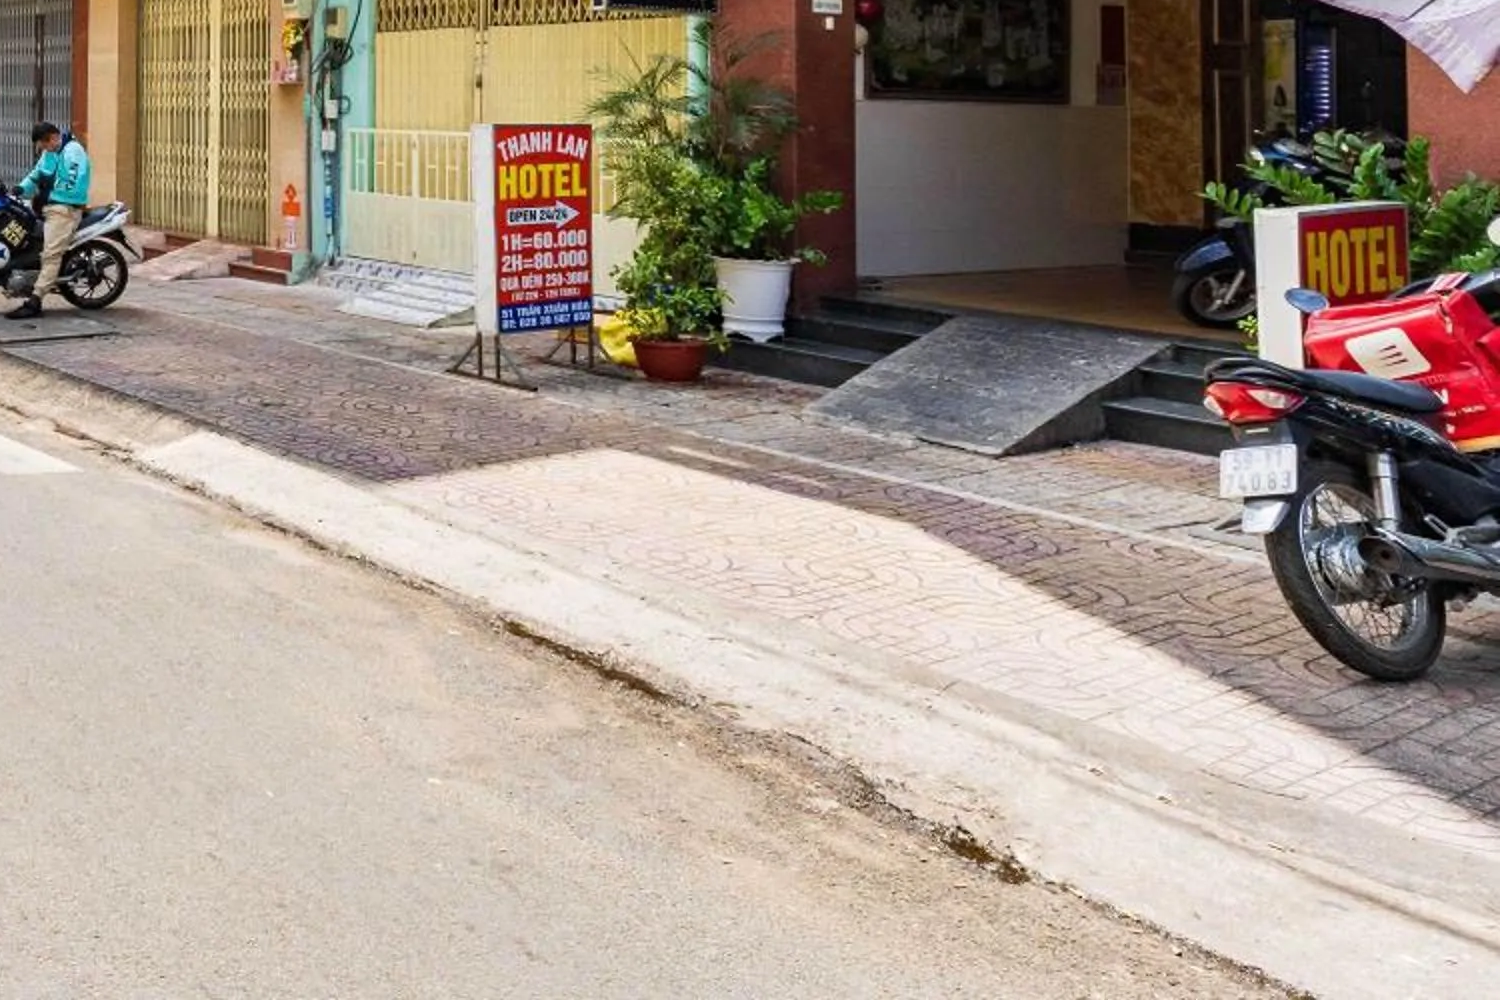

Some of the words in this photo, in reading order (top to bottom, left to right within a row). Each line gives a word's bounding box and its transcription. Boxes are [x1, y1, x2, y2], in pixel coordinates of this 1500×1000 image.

[497, 131, 553, 162] THANH
[557, 131, 589, 161] LAN
[499, 162, 588, 200] HOTEL
[509, 209, 537, 223] OPEN
[539, 207, 569, 222] 24/24
[501, 229, 588, 252] 1H=60.000
[501, 249, 588, 273] 2H=80.000
[1306, 225, 1405, 298] HOTEL
